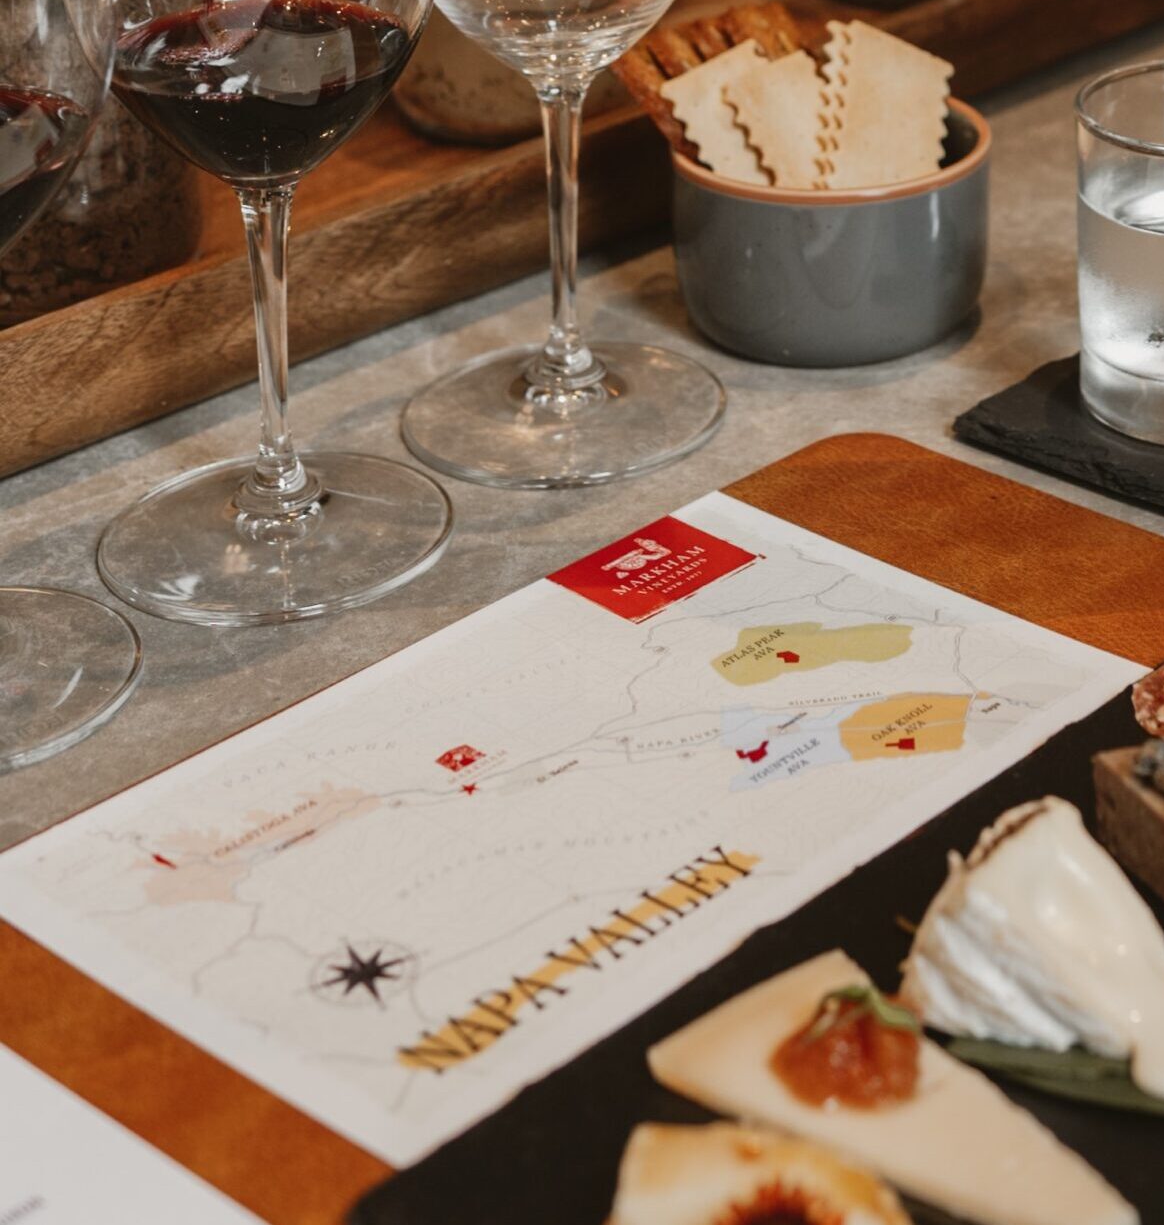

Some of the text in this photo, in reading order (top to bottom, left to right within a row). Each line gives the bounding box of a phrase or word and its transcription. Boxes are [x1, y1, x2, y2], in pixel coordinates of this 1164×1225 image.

[611, 545, 706, 596] MARKHAM
[637, 557, 708, 595] VINEYARDS
[720, 628, 785, 668] ATLAS PEAK
[753, 645, 776, 662] AVA
[852, 689, 883, 700] TRAIL
[636, 727, 721, 751] NAPA RIVER
[871, 701, 934, 743] OAK KNOLL
[904, 718, 927, 736] AVA
[749, 737, 821, 784] YOUNTVILLE
[787, 758, 811, 776] AVA
[213, 813, 292, 858] CALISTOGA
[398, 845, 753, 1075] NAPA VALLEY
